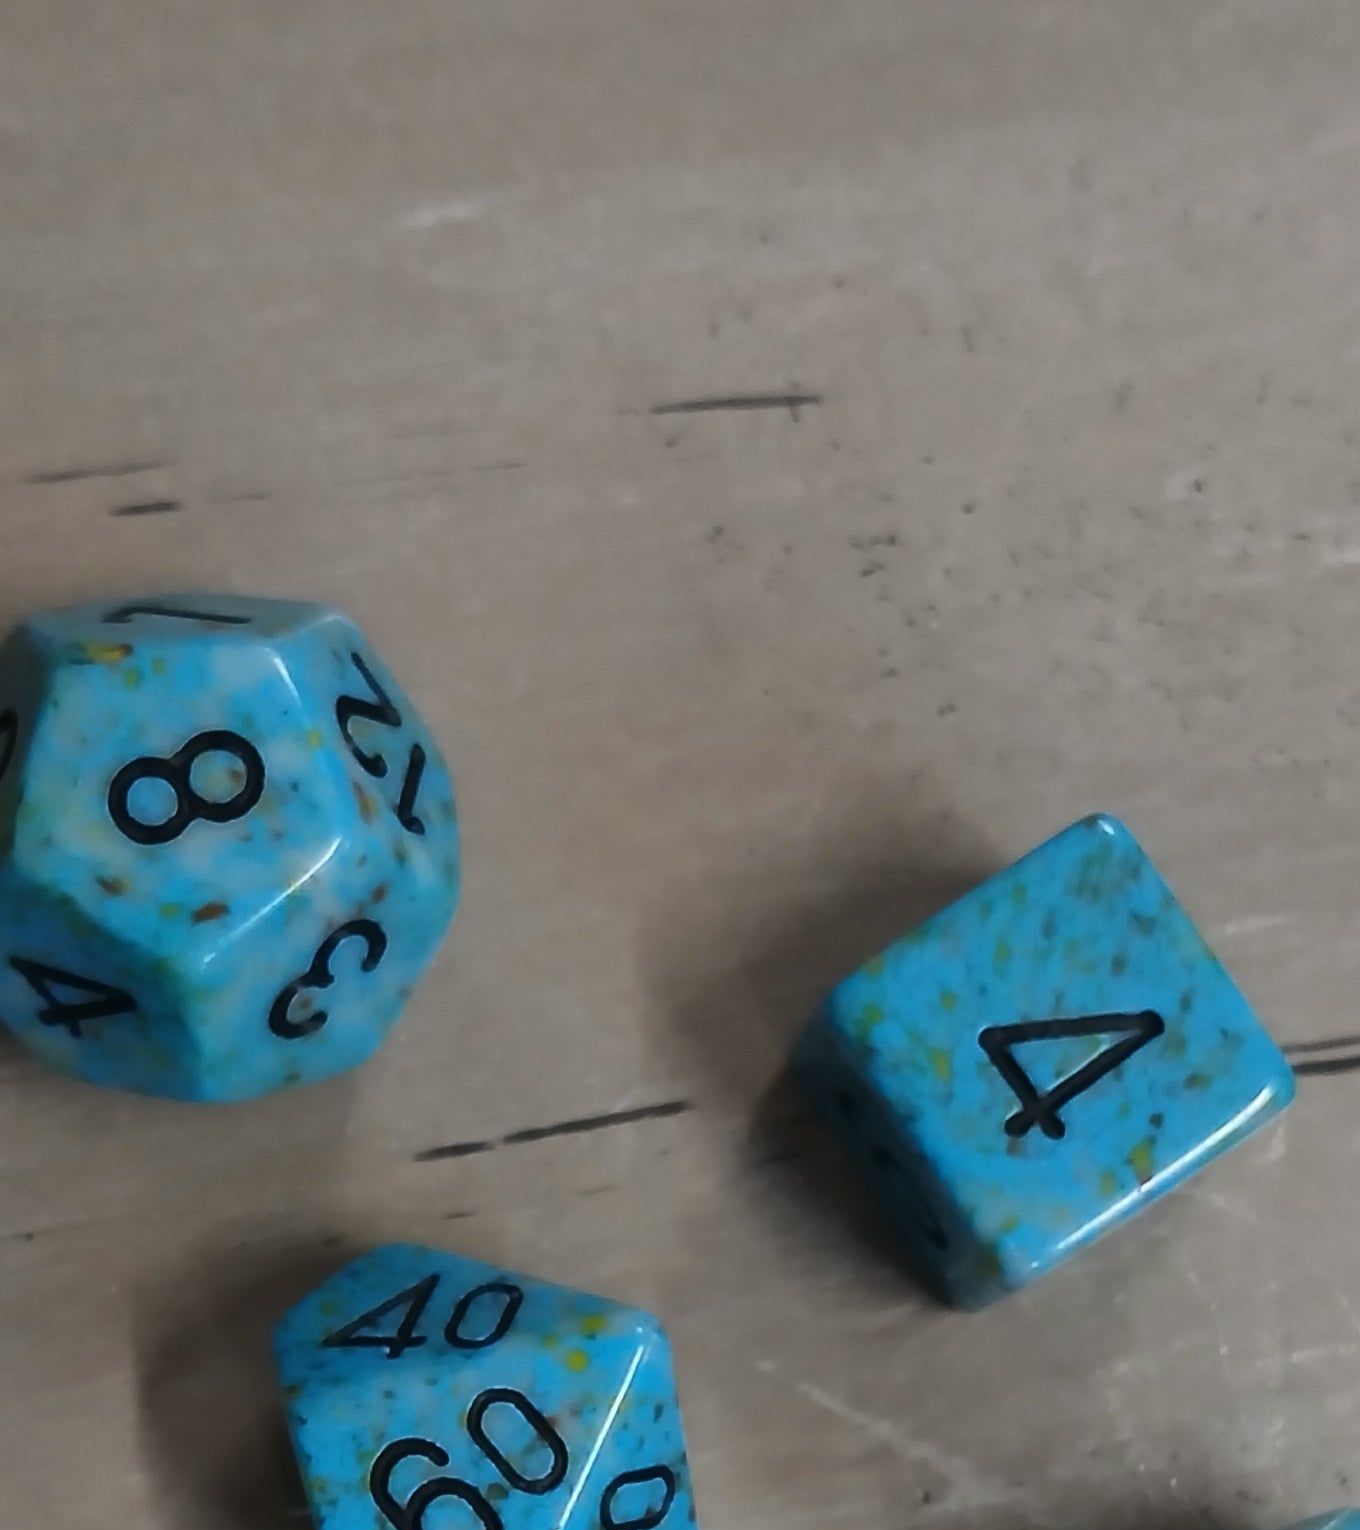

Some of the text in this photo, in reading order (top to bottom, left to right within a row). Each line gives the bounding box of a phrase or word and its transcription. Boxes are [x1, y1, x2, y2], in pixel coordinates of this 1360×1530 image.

[107, 729, 266, 846] 8
[7, 955, 138, 1039] 4
[267, 918, 388, 1041] 3
[977, 1008, 1166, 1141] 4
[321, 1272, 524, 1360] 40
